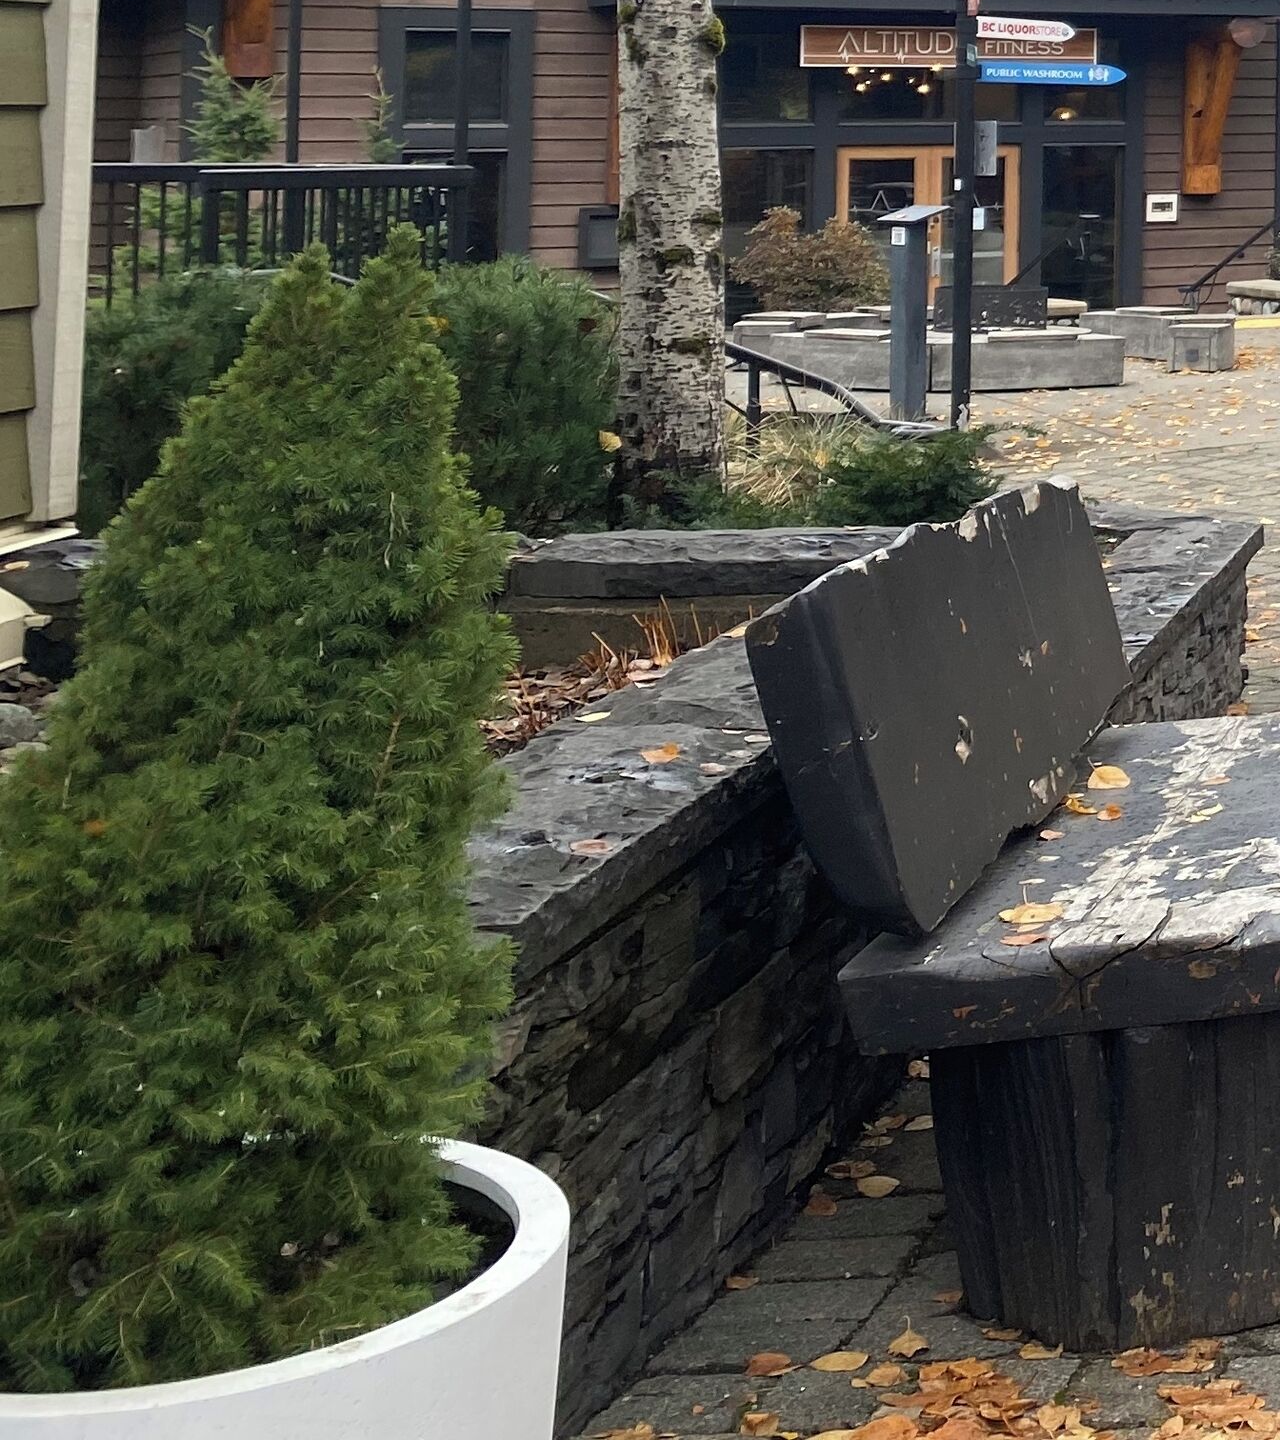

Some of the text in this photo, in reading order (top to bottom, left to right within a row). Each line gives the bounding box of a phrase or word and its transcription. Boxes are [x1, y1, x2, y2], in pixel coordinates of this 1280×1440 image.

[982, 22, 996, 32] BC
[838, 31, 1064, 55] ALTITUD FITNESS
[986, 68, 1083, 79] PUBLIC WASHROOM
